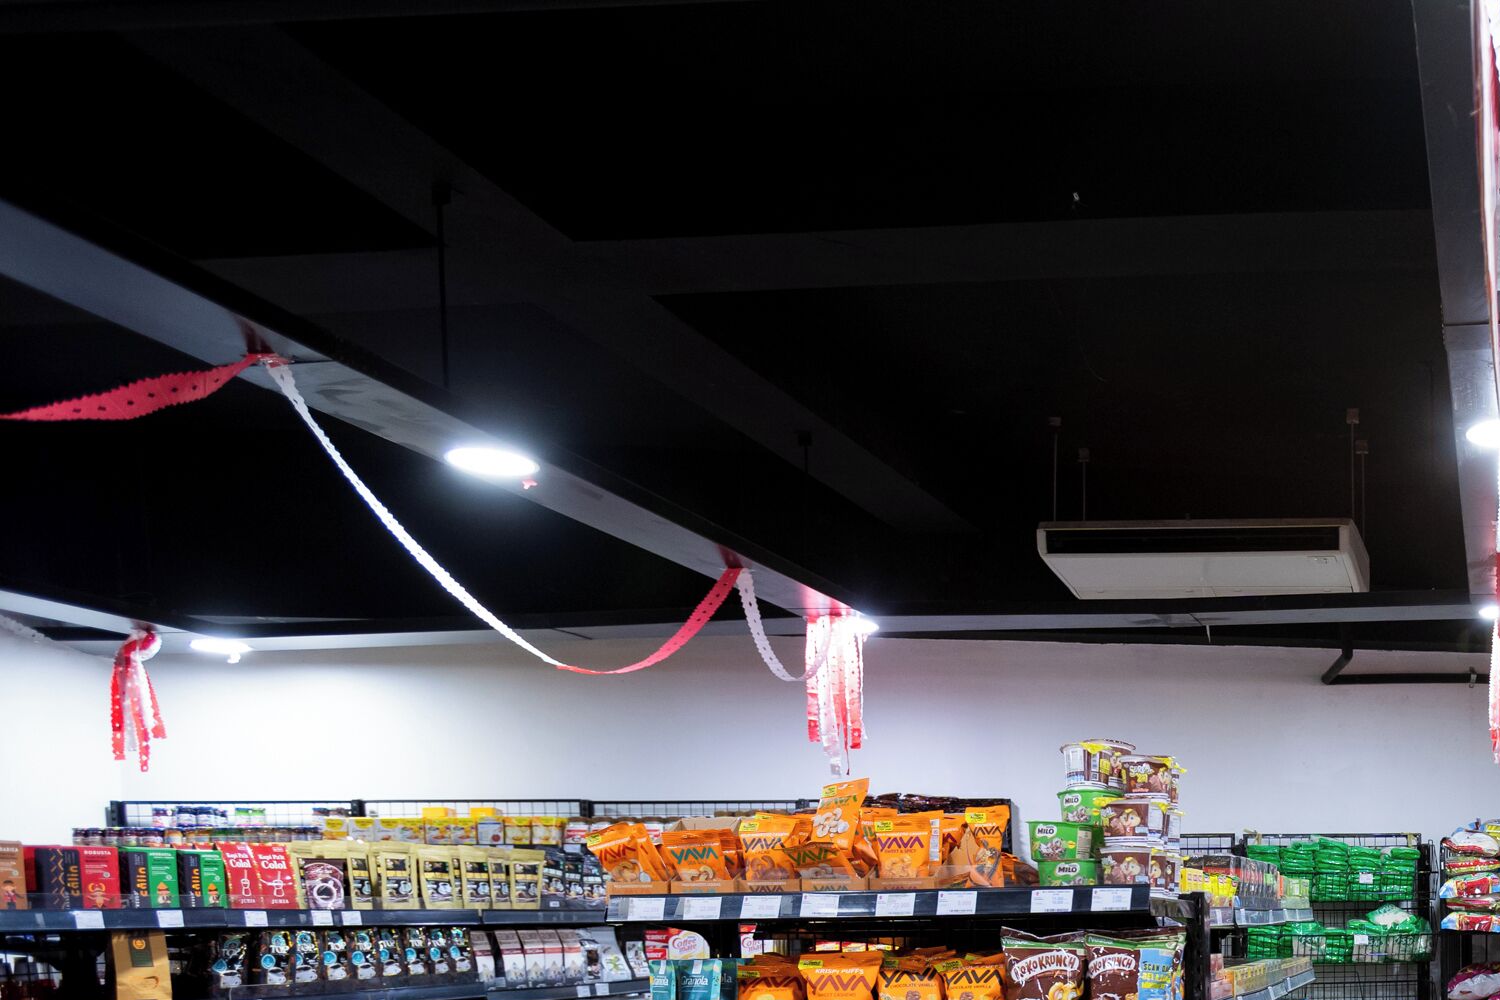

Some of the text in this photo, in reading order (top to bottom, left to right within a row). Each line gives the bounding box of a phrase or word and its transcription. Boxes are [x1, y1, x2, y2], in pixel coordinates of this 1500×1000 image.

[877, 836, 925, 851] YAVA
[671, 847, 719, 864] YAVA
[229, 859, 251, 868] Colol
[261, 860, 287, 869] Colol
[328, 942, 346, 950] TOP
[672, 937, 697, 948] Coffee
[681, 976, 708, 986] Granola
